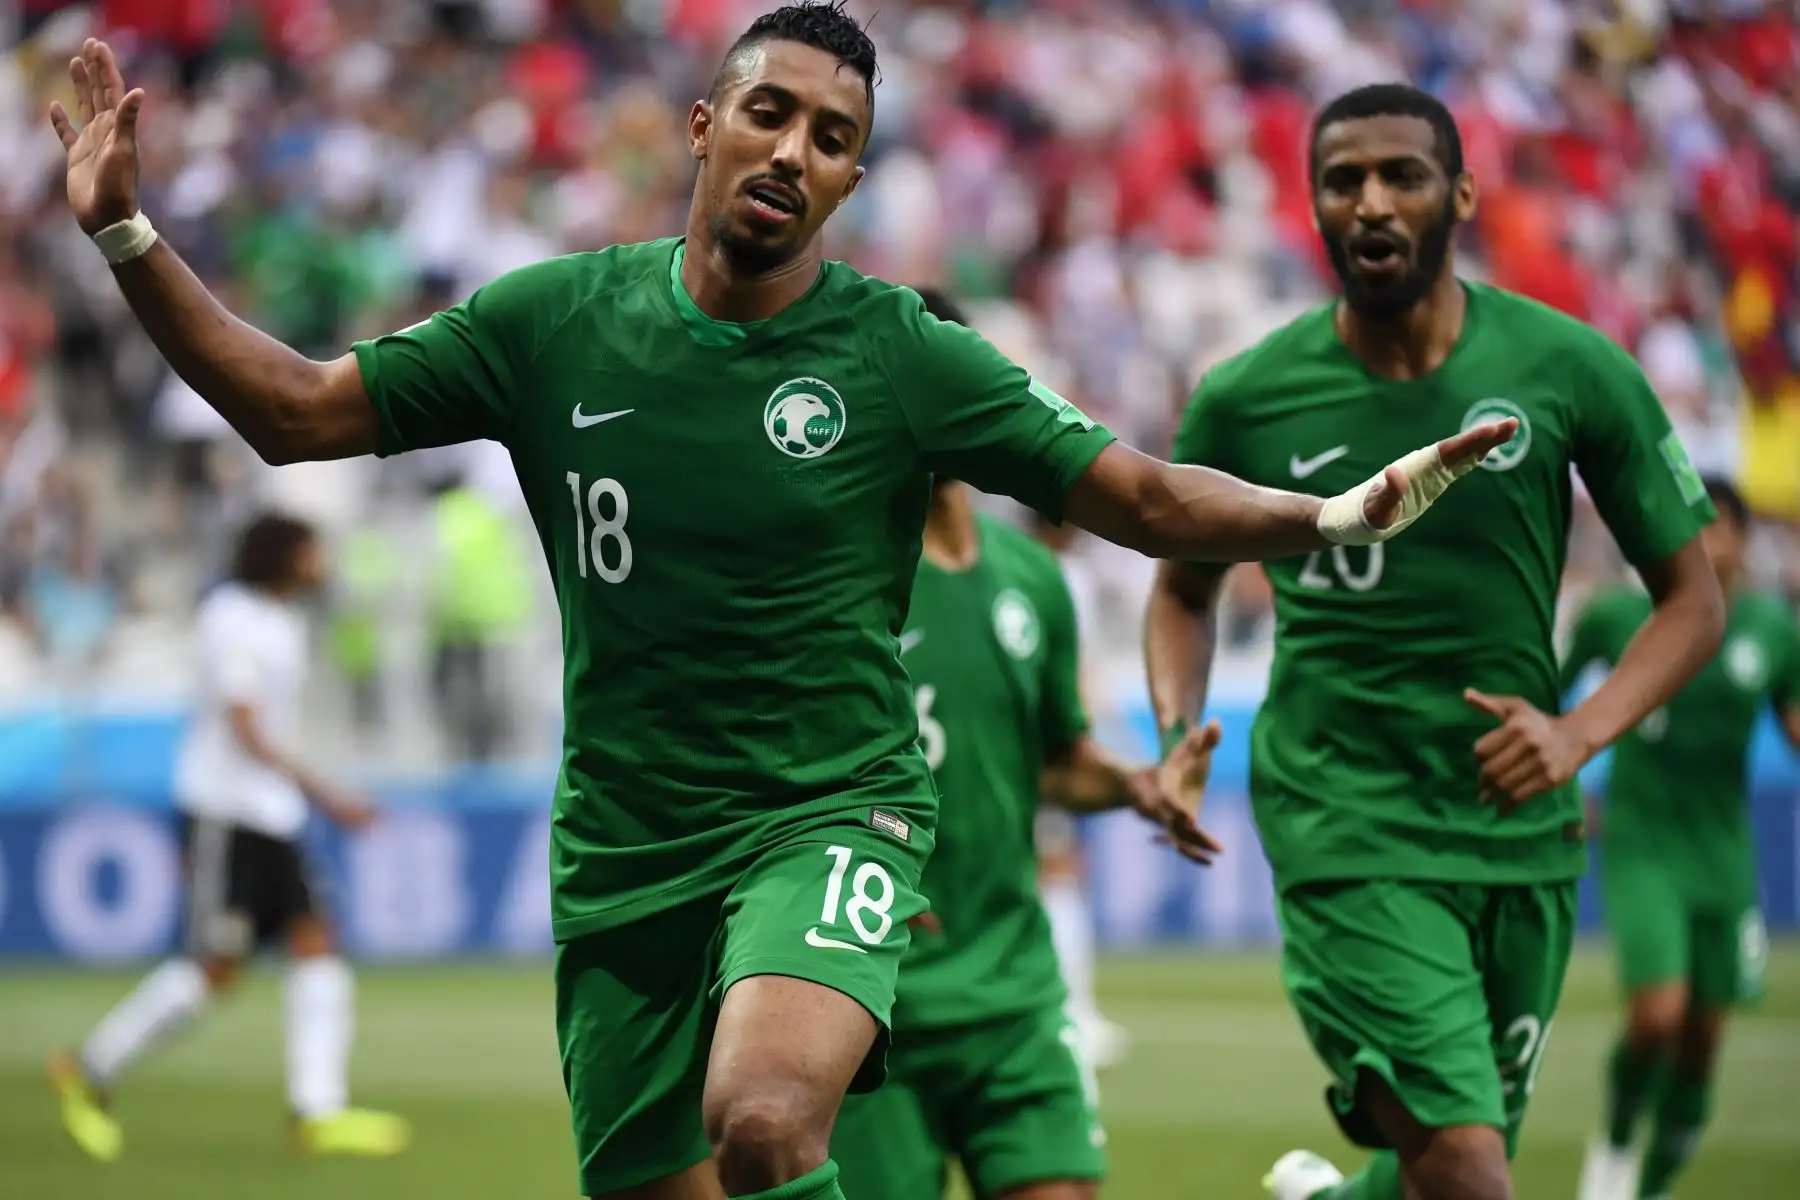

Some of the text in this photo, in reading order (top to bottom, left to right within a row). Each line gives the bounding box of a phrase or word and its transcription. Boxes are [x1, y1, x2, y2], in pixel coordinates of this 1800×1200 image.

[807, 427, 830, 436] SAFF
[567, 471, 633, 584] 18
[821, 845, 895, 945] 18
